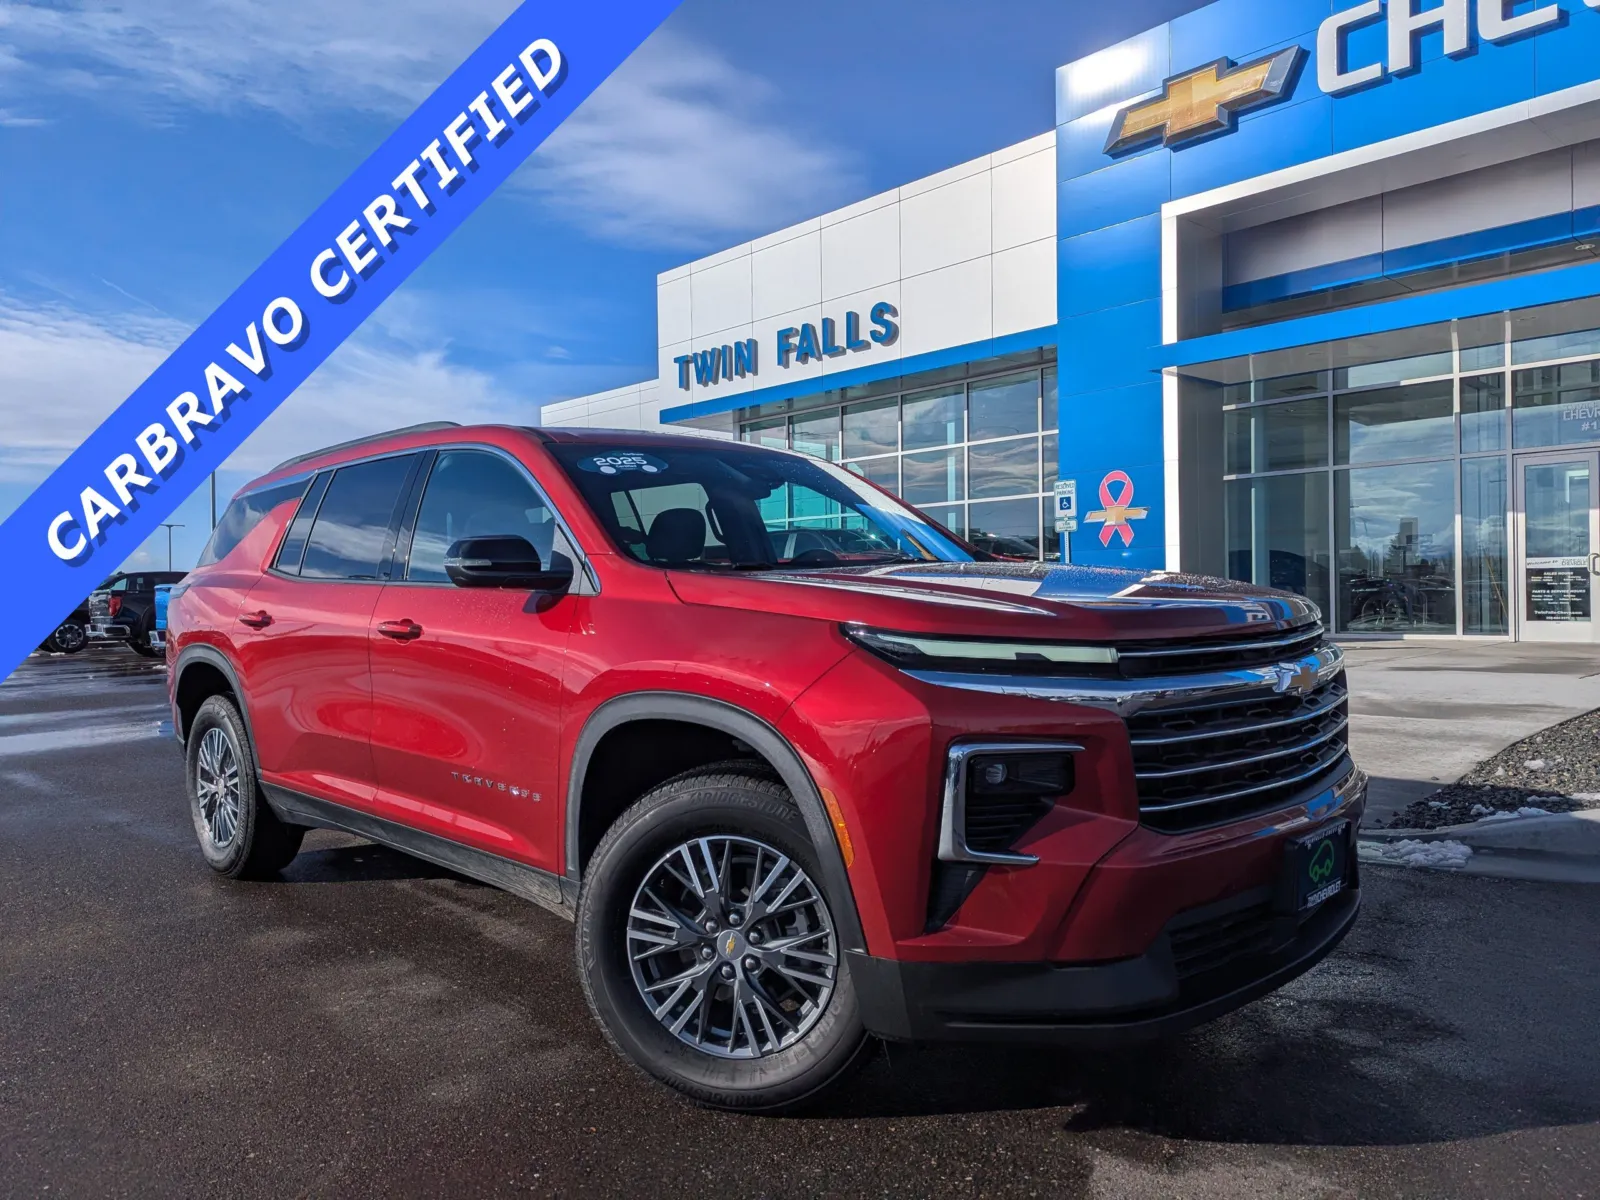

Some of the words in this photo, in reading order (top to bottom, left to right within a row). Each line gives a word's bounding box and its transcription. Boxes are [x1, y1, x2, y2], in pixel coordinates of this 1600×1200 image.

[673, 337, 759, 392] TWIN
[777, 301, 899, 369] FALLS
[592, 456, 648, 466] 2025
[450, 771, 542, 802] TRAVERSE
[689, 790, 799, 823] BRIDGESTONE
